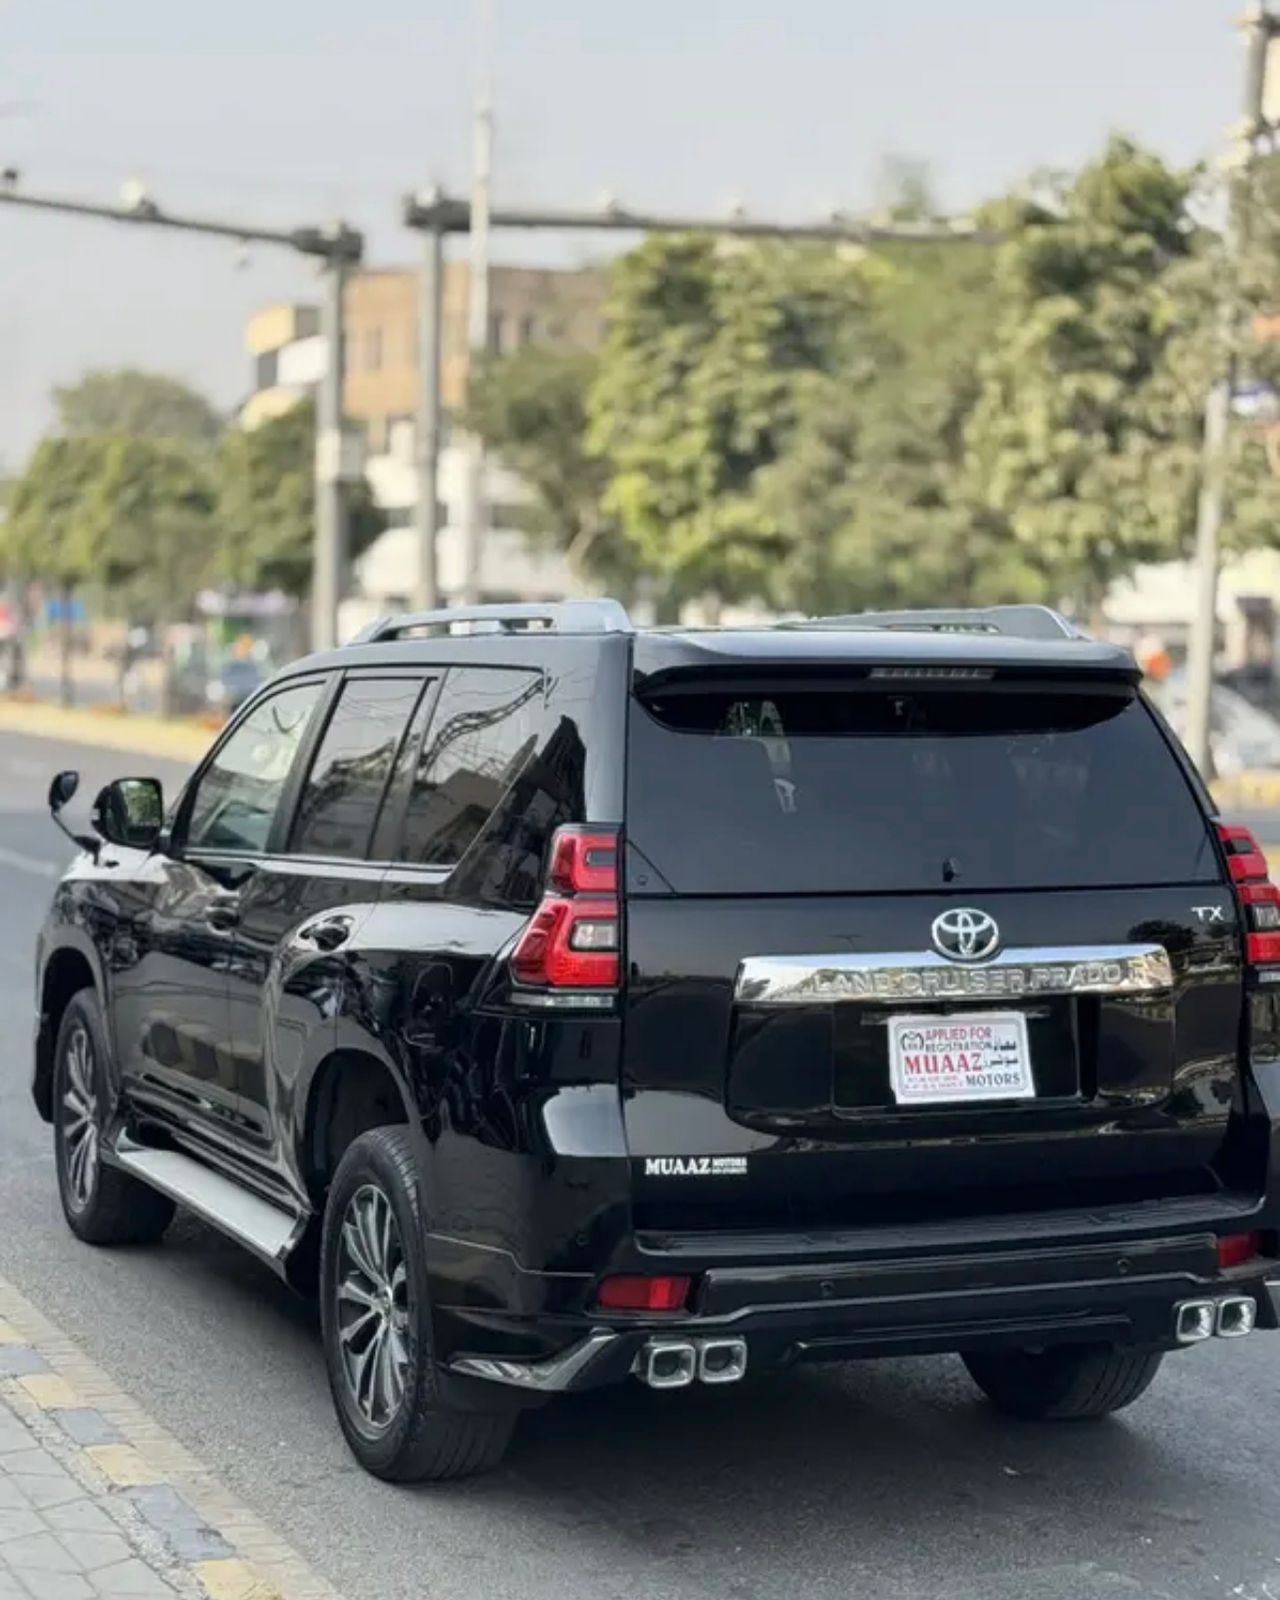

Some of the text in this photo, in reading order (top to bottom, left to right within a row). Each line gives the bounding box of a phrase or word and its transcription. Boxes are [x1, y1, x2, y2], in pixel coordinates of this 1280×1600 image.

[1191, 905, 1224, 921] TX
[925, 1026, 992, 1041] APPLIED FOR
[904, 1053, 982, 1075] MUAAZ
[965, 1072, 1021, 1087] MOTORS
[645, 1158, 710, 1175] MUAAZ
